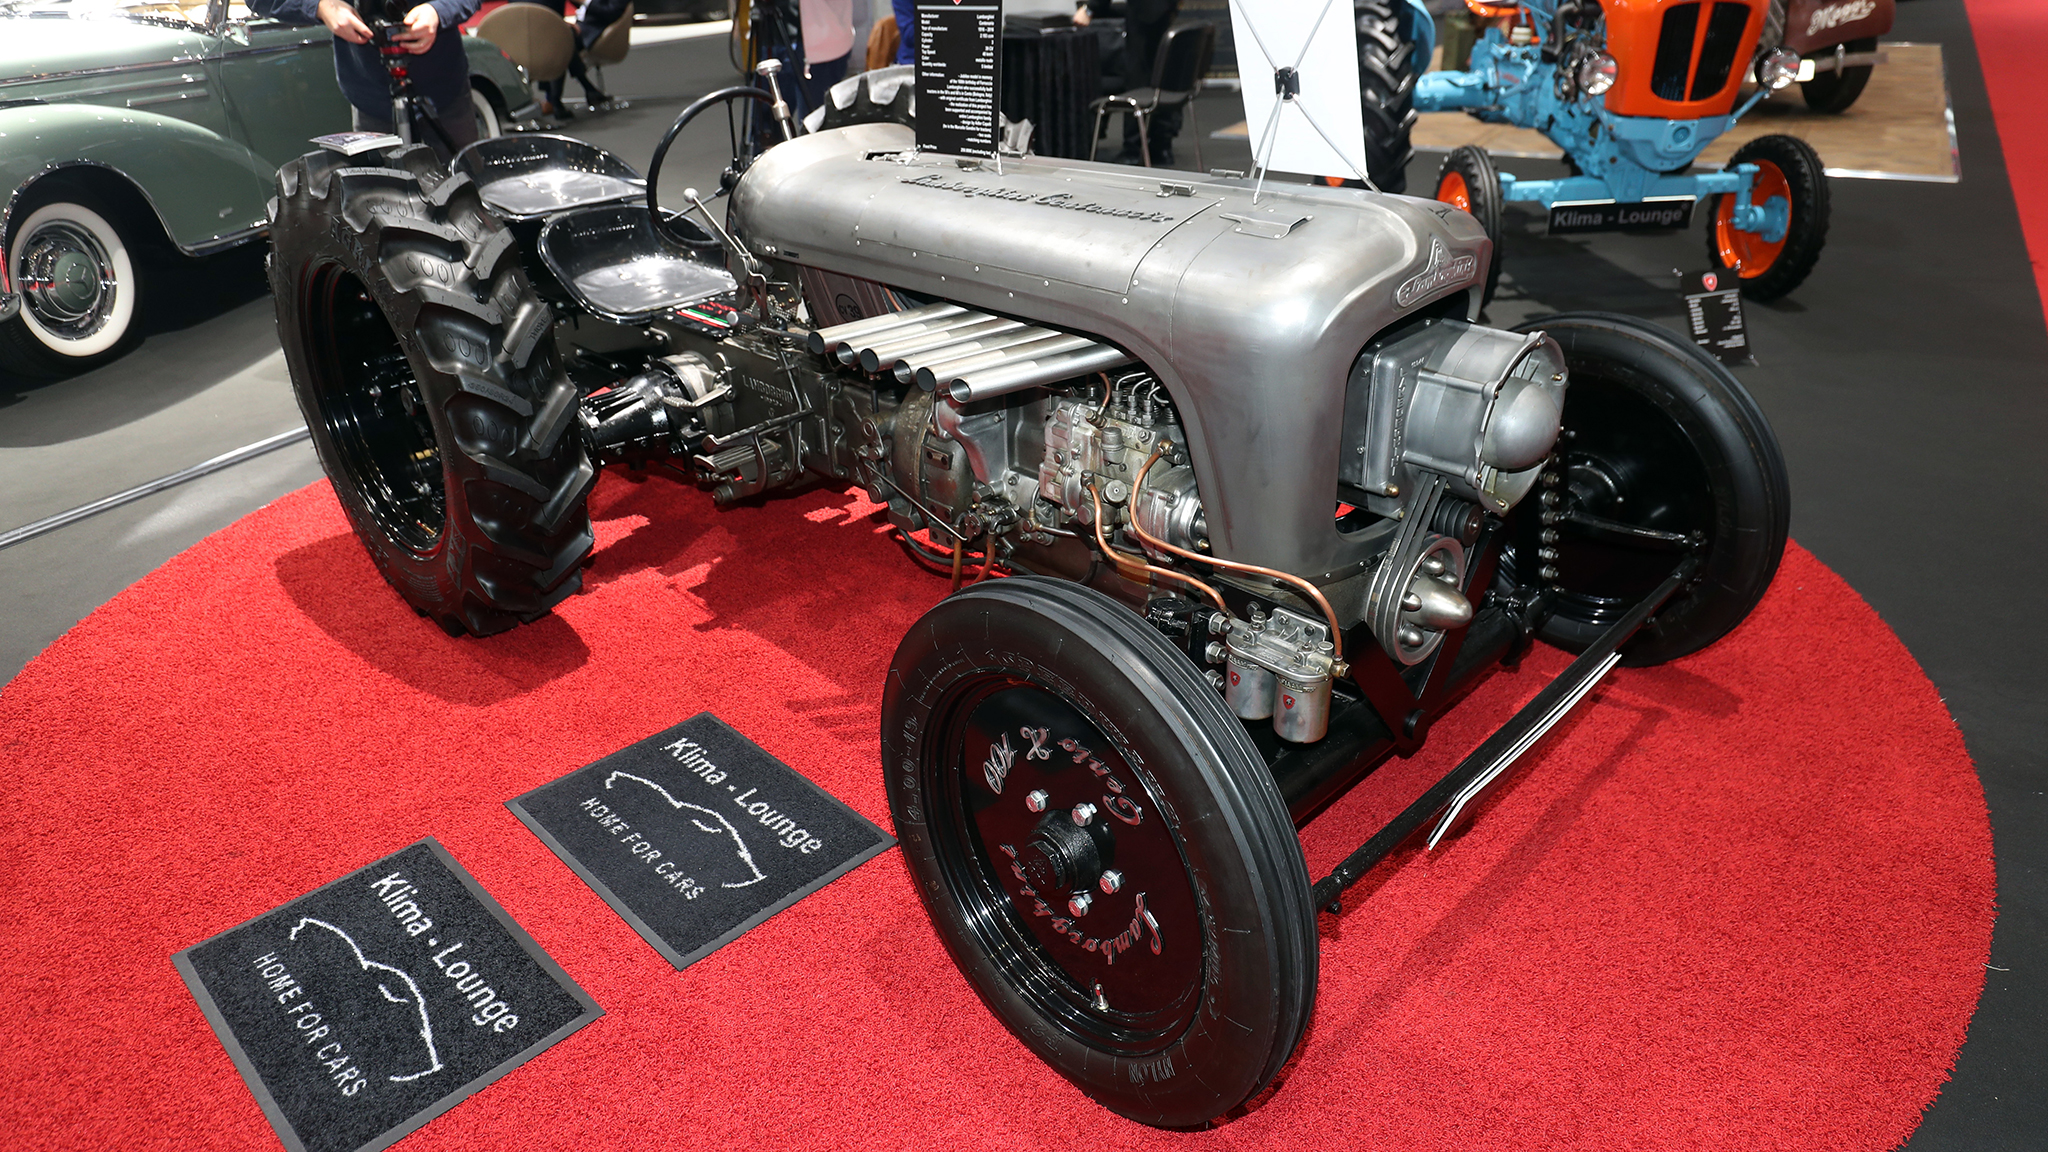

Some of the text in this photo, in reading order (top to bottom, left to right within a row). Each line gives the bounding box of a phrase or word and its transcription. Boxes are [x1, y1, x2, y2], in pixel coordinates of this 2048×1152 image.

[1553, 211, 1603, 227] Klima
[662, 737, 729, 786] Klima
[733, 787, 823, 855] Lounge
[1057, 736, 1146, 826] Cento
[579, 796, 706, 900] HOME FOR CARS
[999, 842, 1166, 966] Lamborghini
[370, 871, 434, 937] Klima
[432, 942, 520, 1034] Lounge
[253, 950, 368, 1097] HOME FOR CARS
